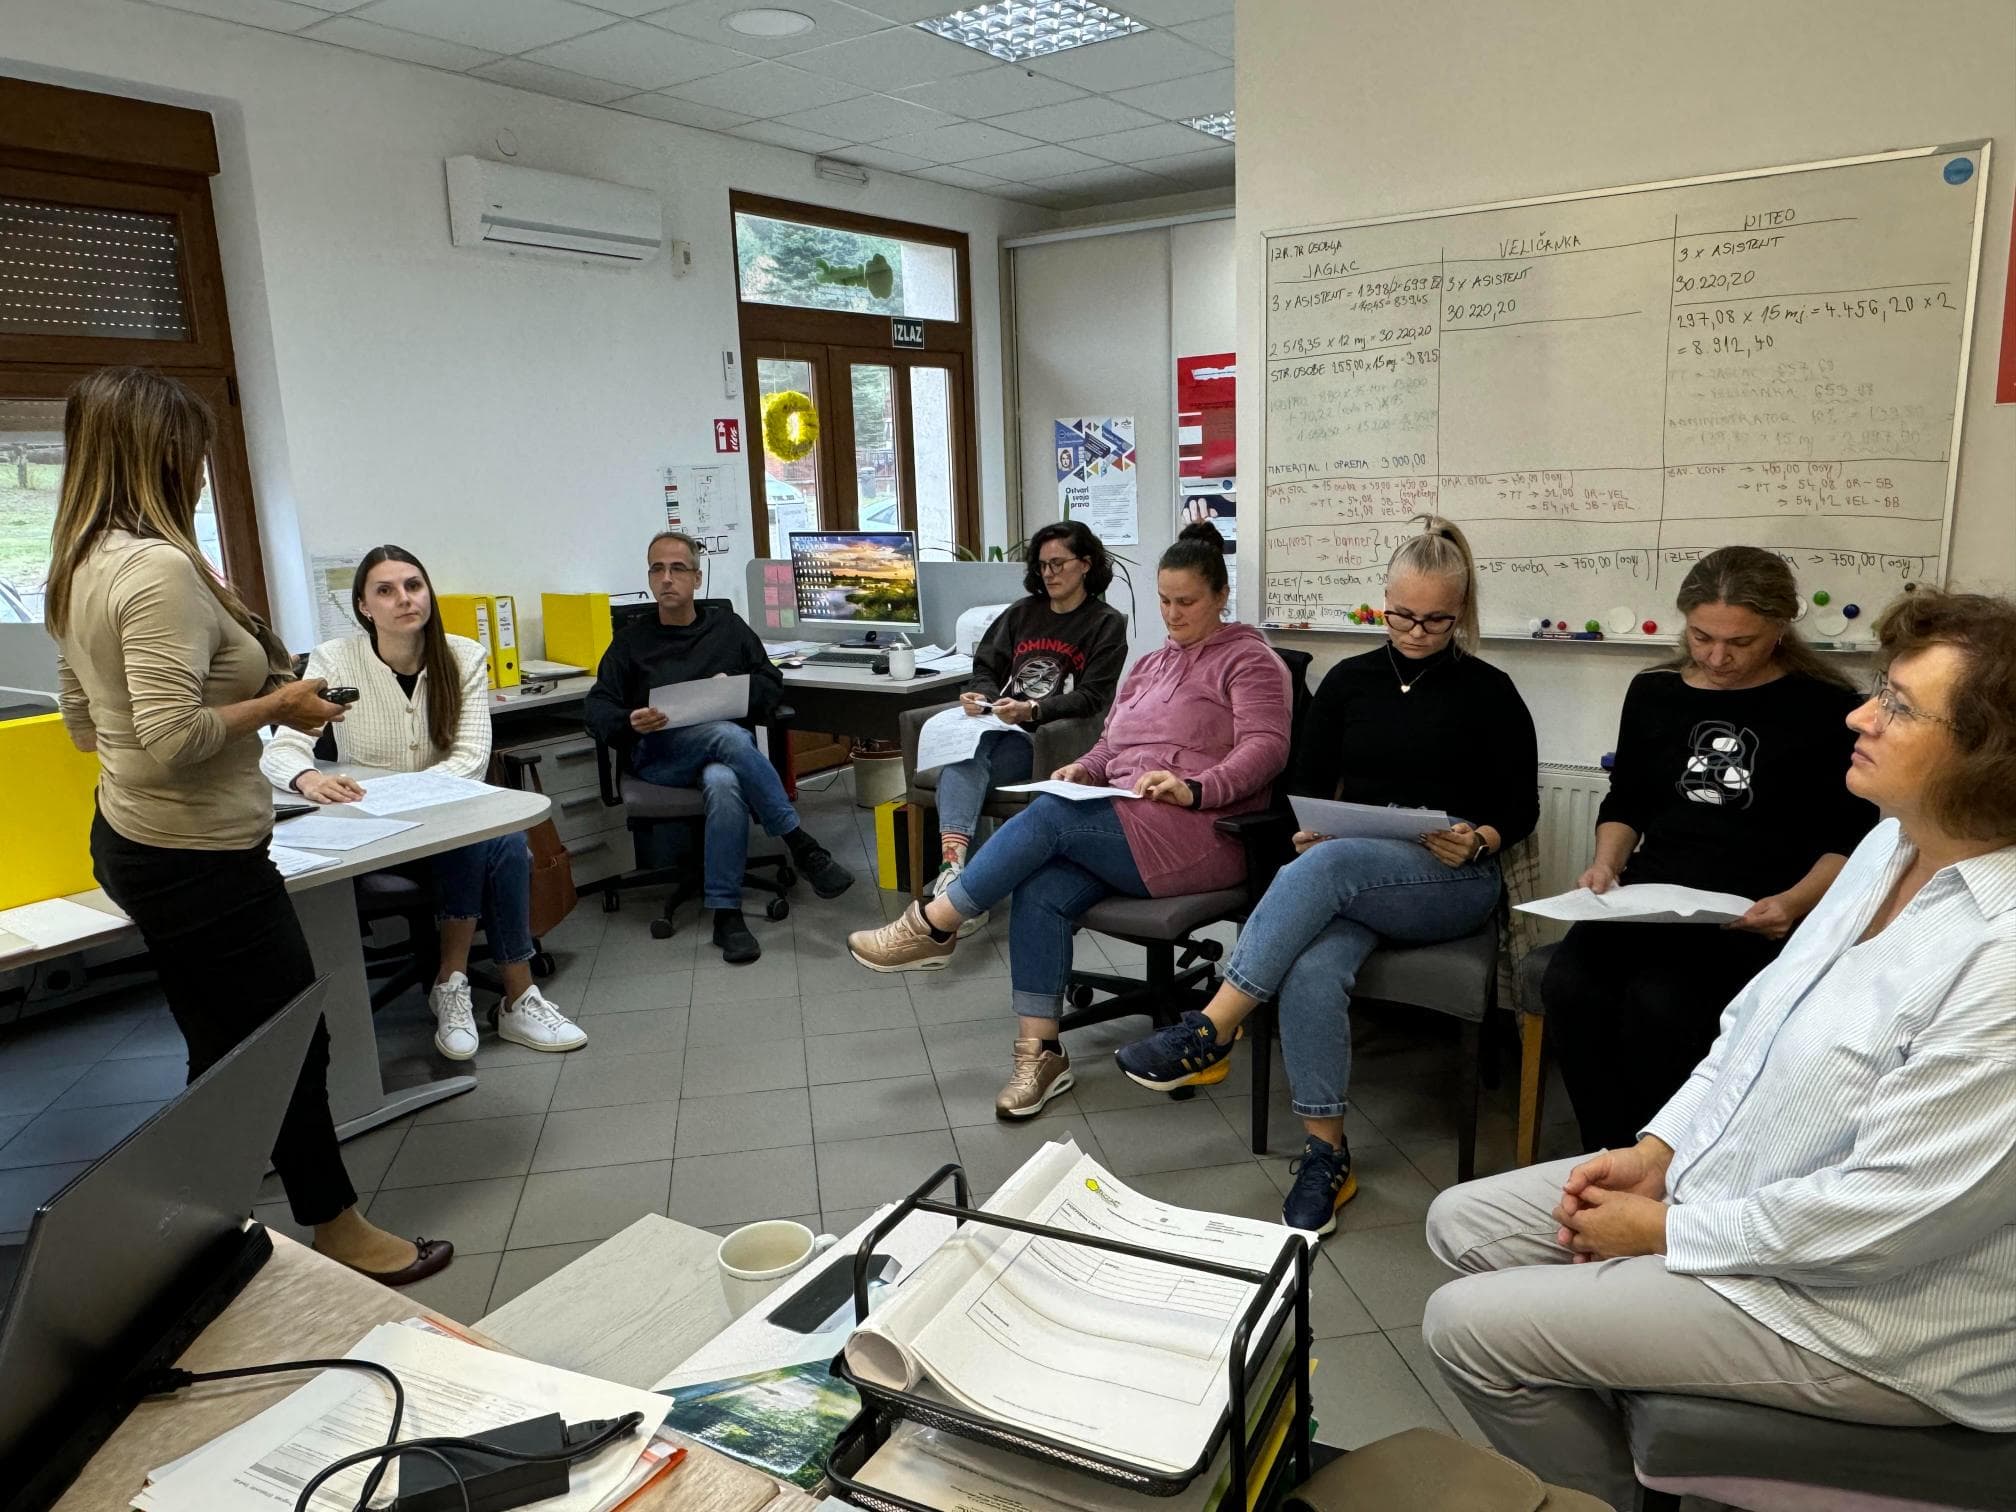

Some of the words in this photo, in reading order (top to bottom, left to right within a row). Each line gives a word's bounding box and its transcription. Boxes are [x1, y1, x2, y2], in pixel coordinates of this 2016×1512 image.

[1679, 248, 1689, 262] 3
[1472, 267, 1532, 288] ASISTENT
[1272, 295, 1280, 311] 3
[1938, 292, 1956, 310] 2
[894, 324, 922, 342] IZLAZ
[1334, 530, 1372, 547] banner
